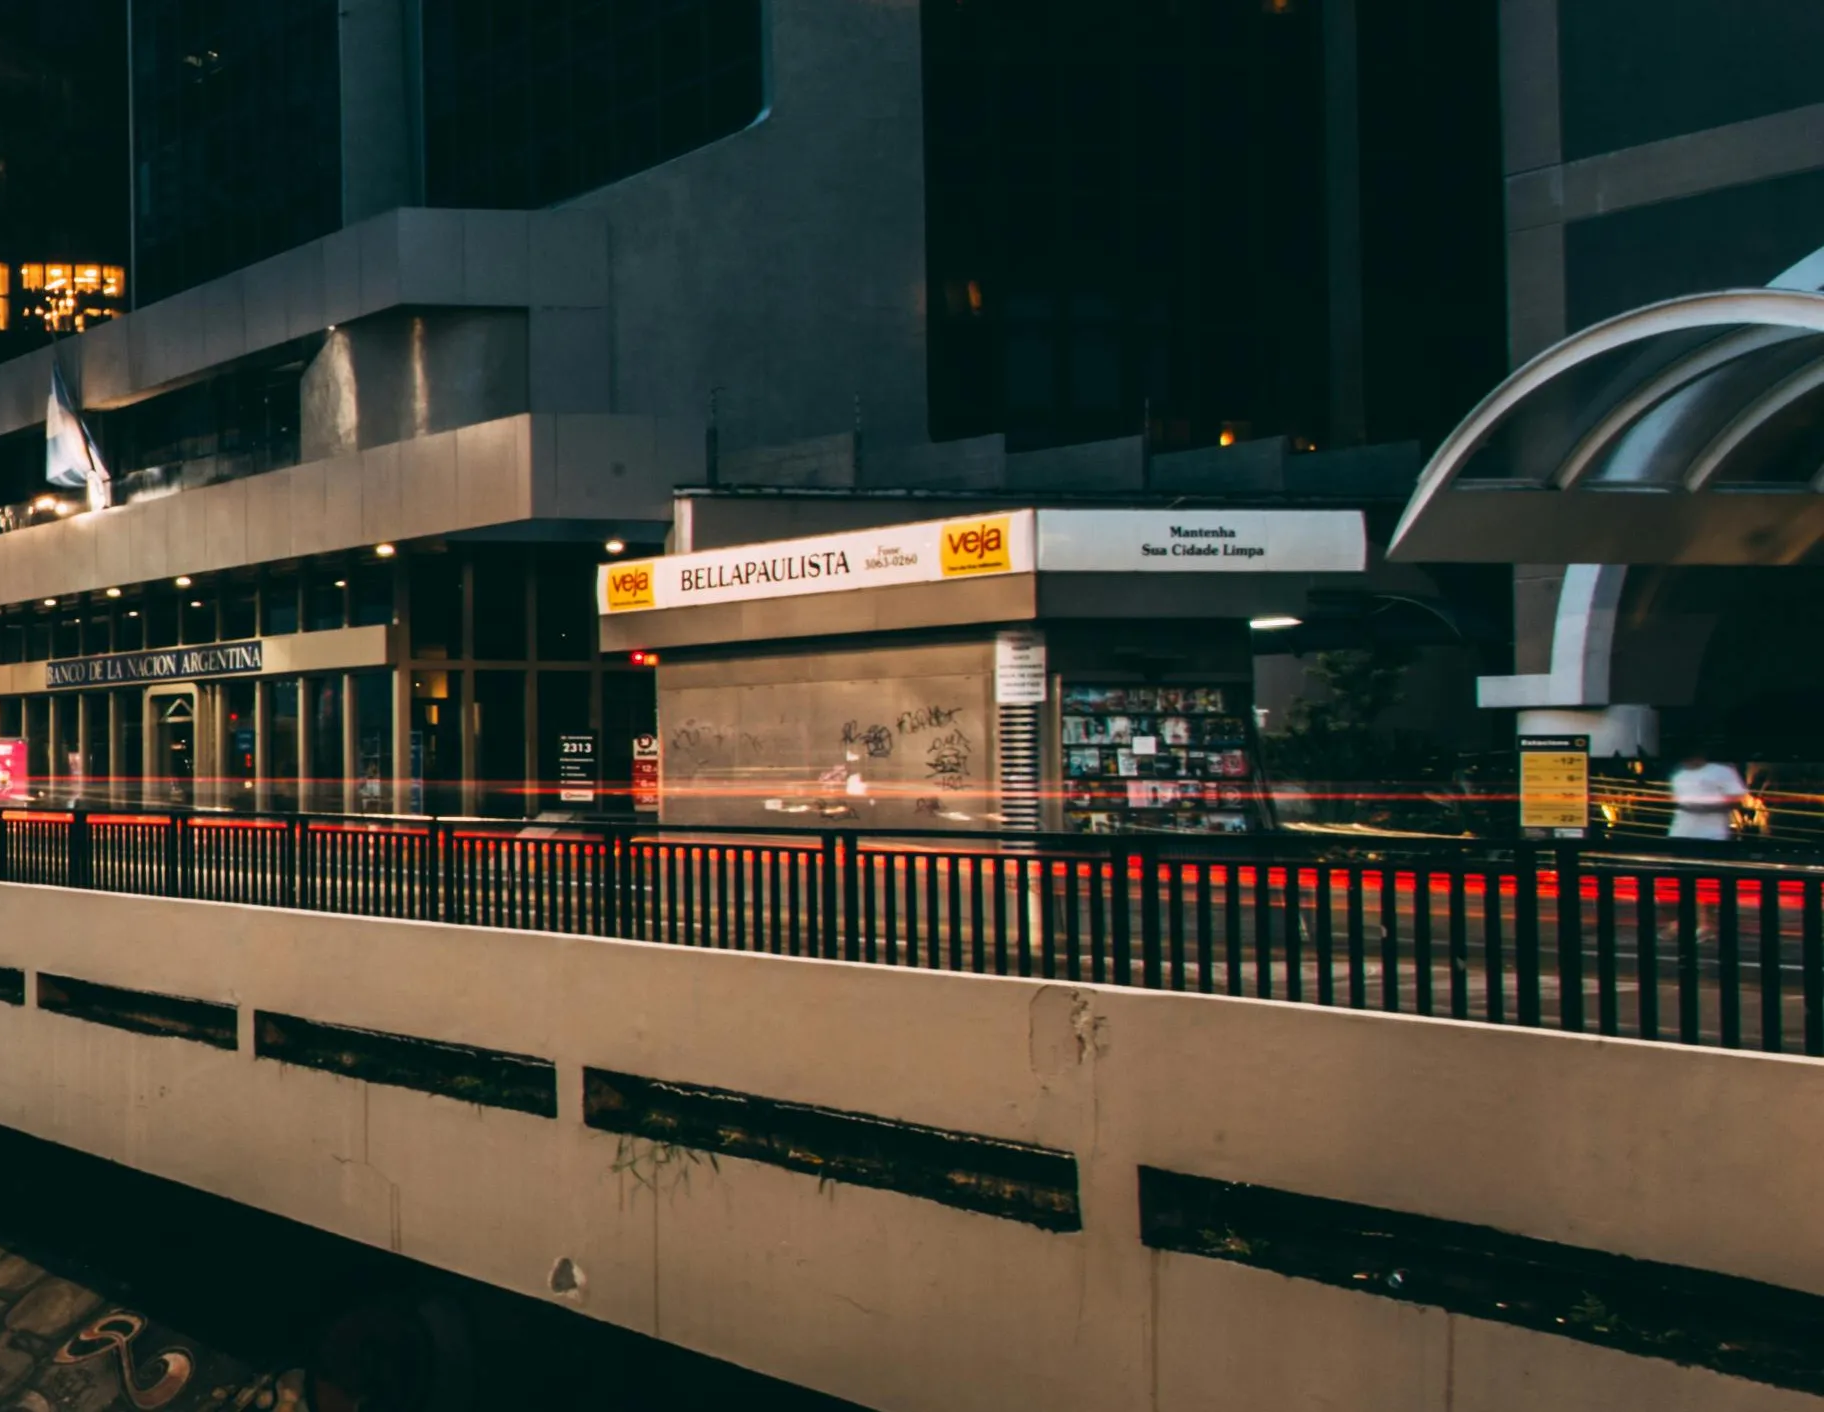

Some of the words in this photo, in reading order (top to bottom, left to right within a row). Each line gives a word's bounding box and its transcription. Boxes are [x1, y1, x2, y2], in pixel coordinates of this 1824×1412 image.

[947, 524, 1001, 559] veja
[1170, 526, 1236, 538] Mantenha
[1141, 543, 1167, 556] Sua
[1172, 543, 1219, 556] Cidade
[1223, 544, 1264, 559] Limpa
[611, 568, 649, 597] veja
[680, 551, 850, 592] BELLAPAULISTA
[46, 663, 85, 685] BANCO
[89, 661, 102, 681] DE
[107, 659, 123, 680] LA
[126, 653, 177, 678] NACION
[181, 646, 262, 674] ARGENTINA
[562, 743, 592, 753] 2313
